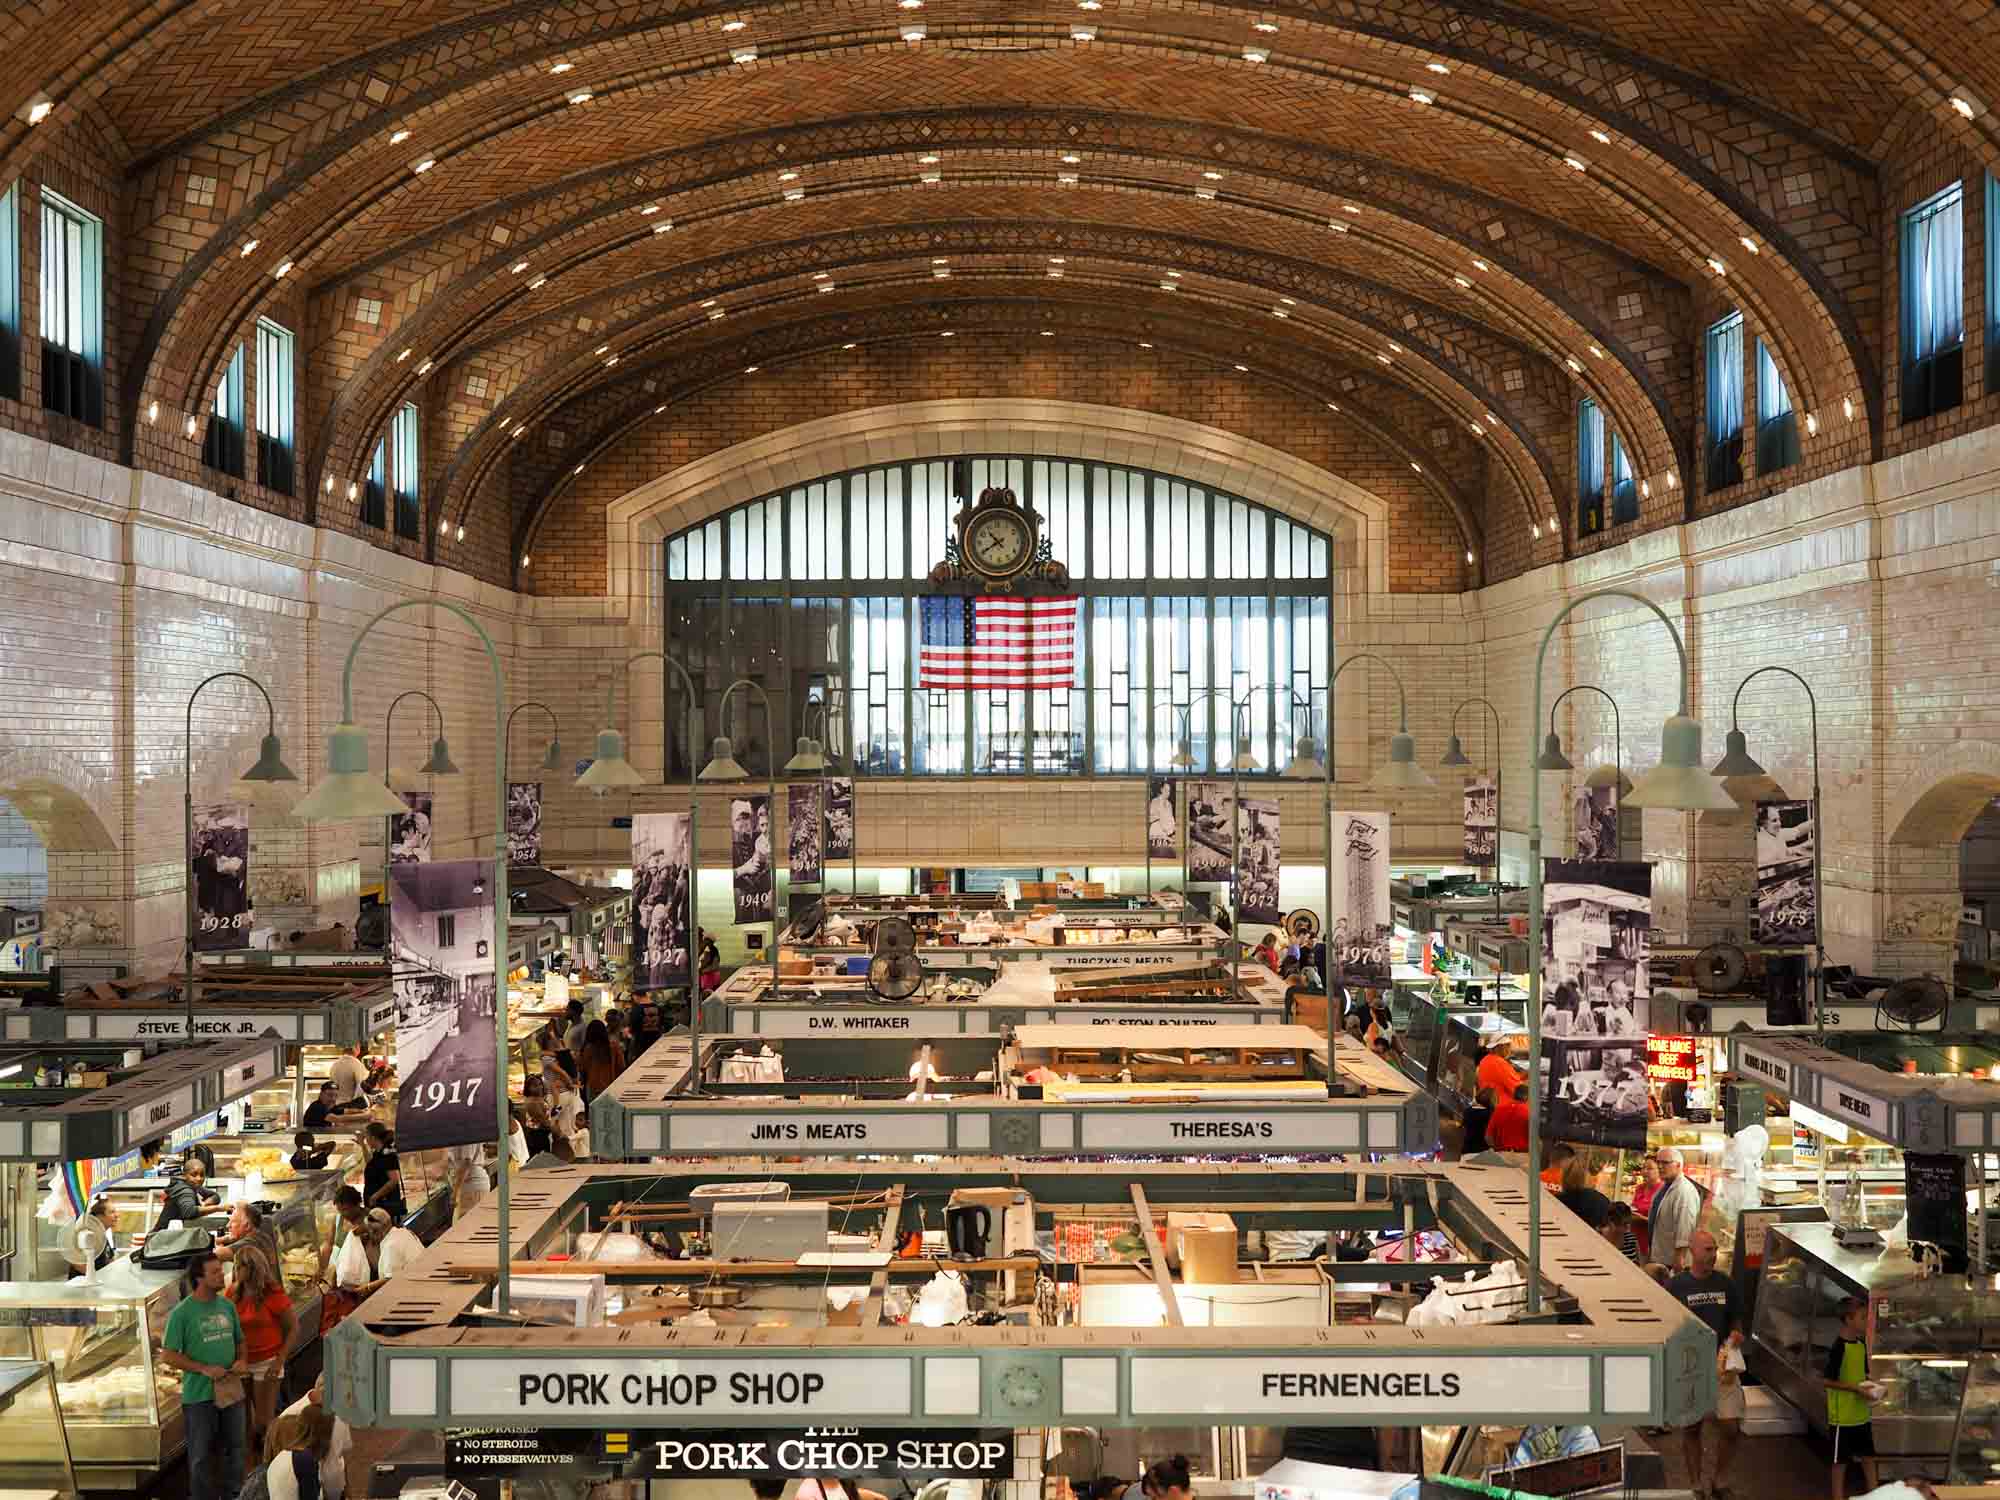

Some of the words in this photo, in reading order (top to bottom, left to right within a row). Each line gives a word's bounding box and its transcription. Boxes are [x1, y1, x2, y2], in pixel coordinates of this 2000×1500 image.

[739, 892, 768, 908] 1940
[1241, 891, 1274, 908] 1972
[200, 913, 242, 932] 1928
[641, 948, 686, 968] 1927
[1342, 945, 1382, 965] 1976
[138, 1023, 180, 1034] STEVE
[237, 1022, 257, 1034] JR.
[809, 1017, 838, 1029] D.W.
[843, 1017, 909, 1029] WHITAKER
[410, 1077, 483, 1112] 1917
[1555, 1076, 1633, 1110] 1977
[751, 1124, 798, 1140] JIM'S
[806, 1124, 867, 1140] MEATS
[1170, 1122, 1273, 1138] THERESA'S
[519, 1374, 610, 1405] PORK
[621, 1374, 717, 1405] CHOP
[729, 1373, 824, 1405] SHOP
[1262, 1373, 1460, 1397] FERNENGELS
[463, 1440, 481, 1449] NO
[482, 1440, 538, 1449] STEROIDS
[463, 1455, 481, 1464] NO
[482, 1455, 574, 1464] PRESERVATIVES
[655, 1441, 770, 1471] PORK
[776, 1439, 889, 1471] CHOP
[896, 1440, 1006, 1470] SHOP
